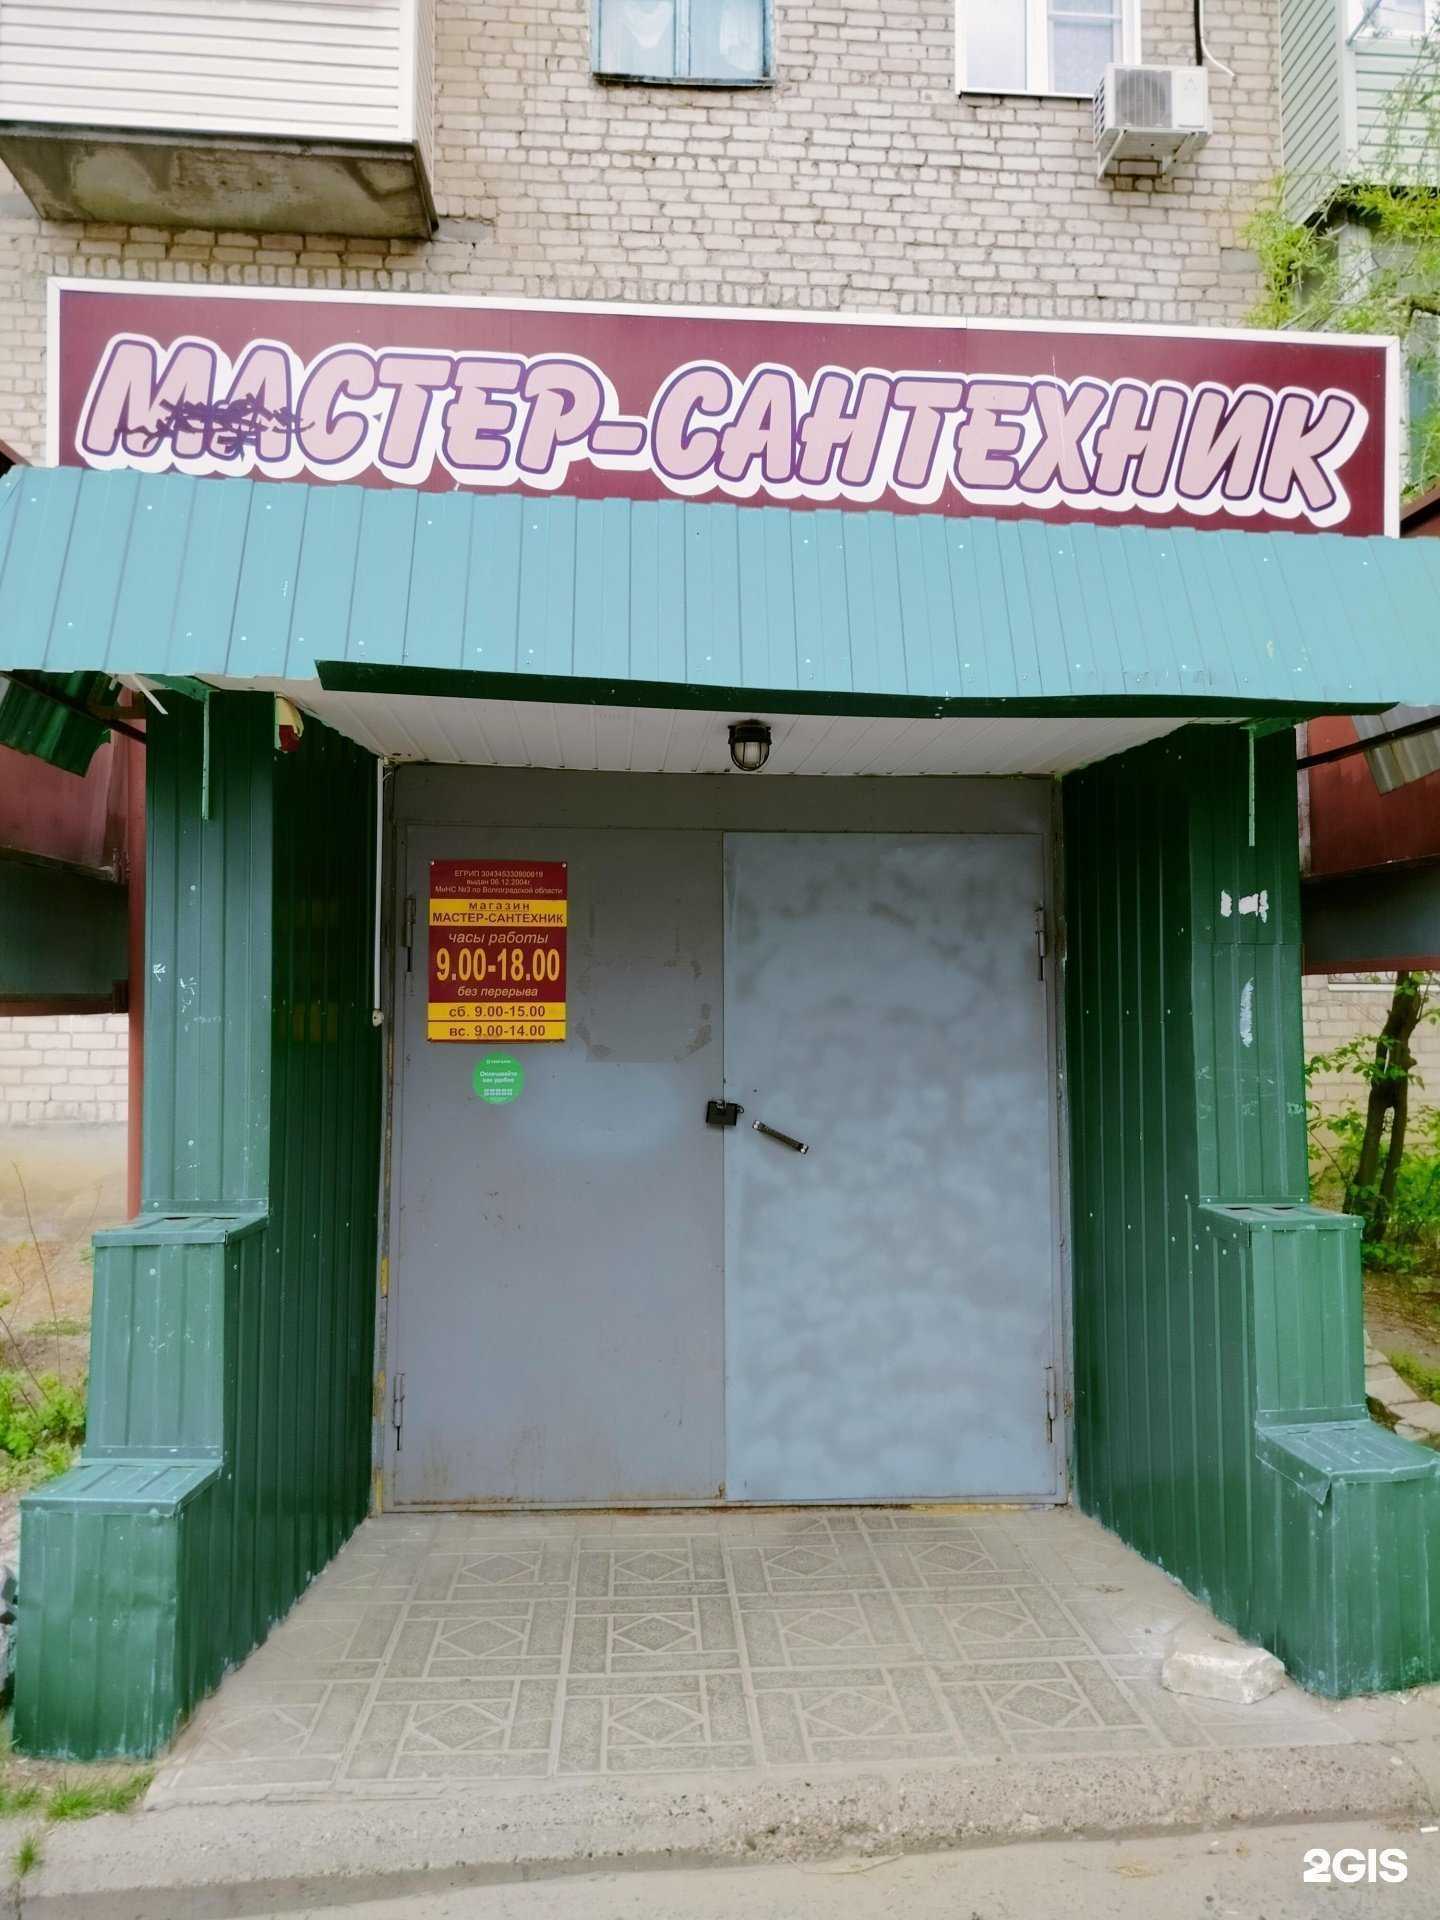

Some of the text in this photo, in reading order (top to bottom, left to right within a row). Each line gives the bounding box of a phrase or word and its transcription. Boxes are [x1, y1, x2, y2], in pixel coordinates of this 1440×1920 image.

[79, 334, 1364, 522] МАСТЕР-САНТЕХНИК
[454, 869, 480, 877] ЕГРИП
[482, 886, 533, 894] Волгоградской
[534, 886, 563, 894] области
[468, 902, 530, 911] магазин
[432, 912, 564, 924] МАСТЕР-САНТЕХНИК
[448, 930, 549, 946] часы работы
[436, 947, 560, 982] 9.00-18.00
[457, 985, 539, 999] без перерыва
[449, 1005, 546, 1018] сб. 9.00-15.00
[449, 1024, 546, 1037] вс. 9.00-14.00
